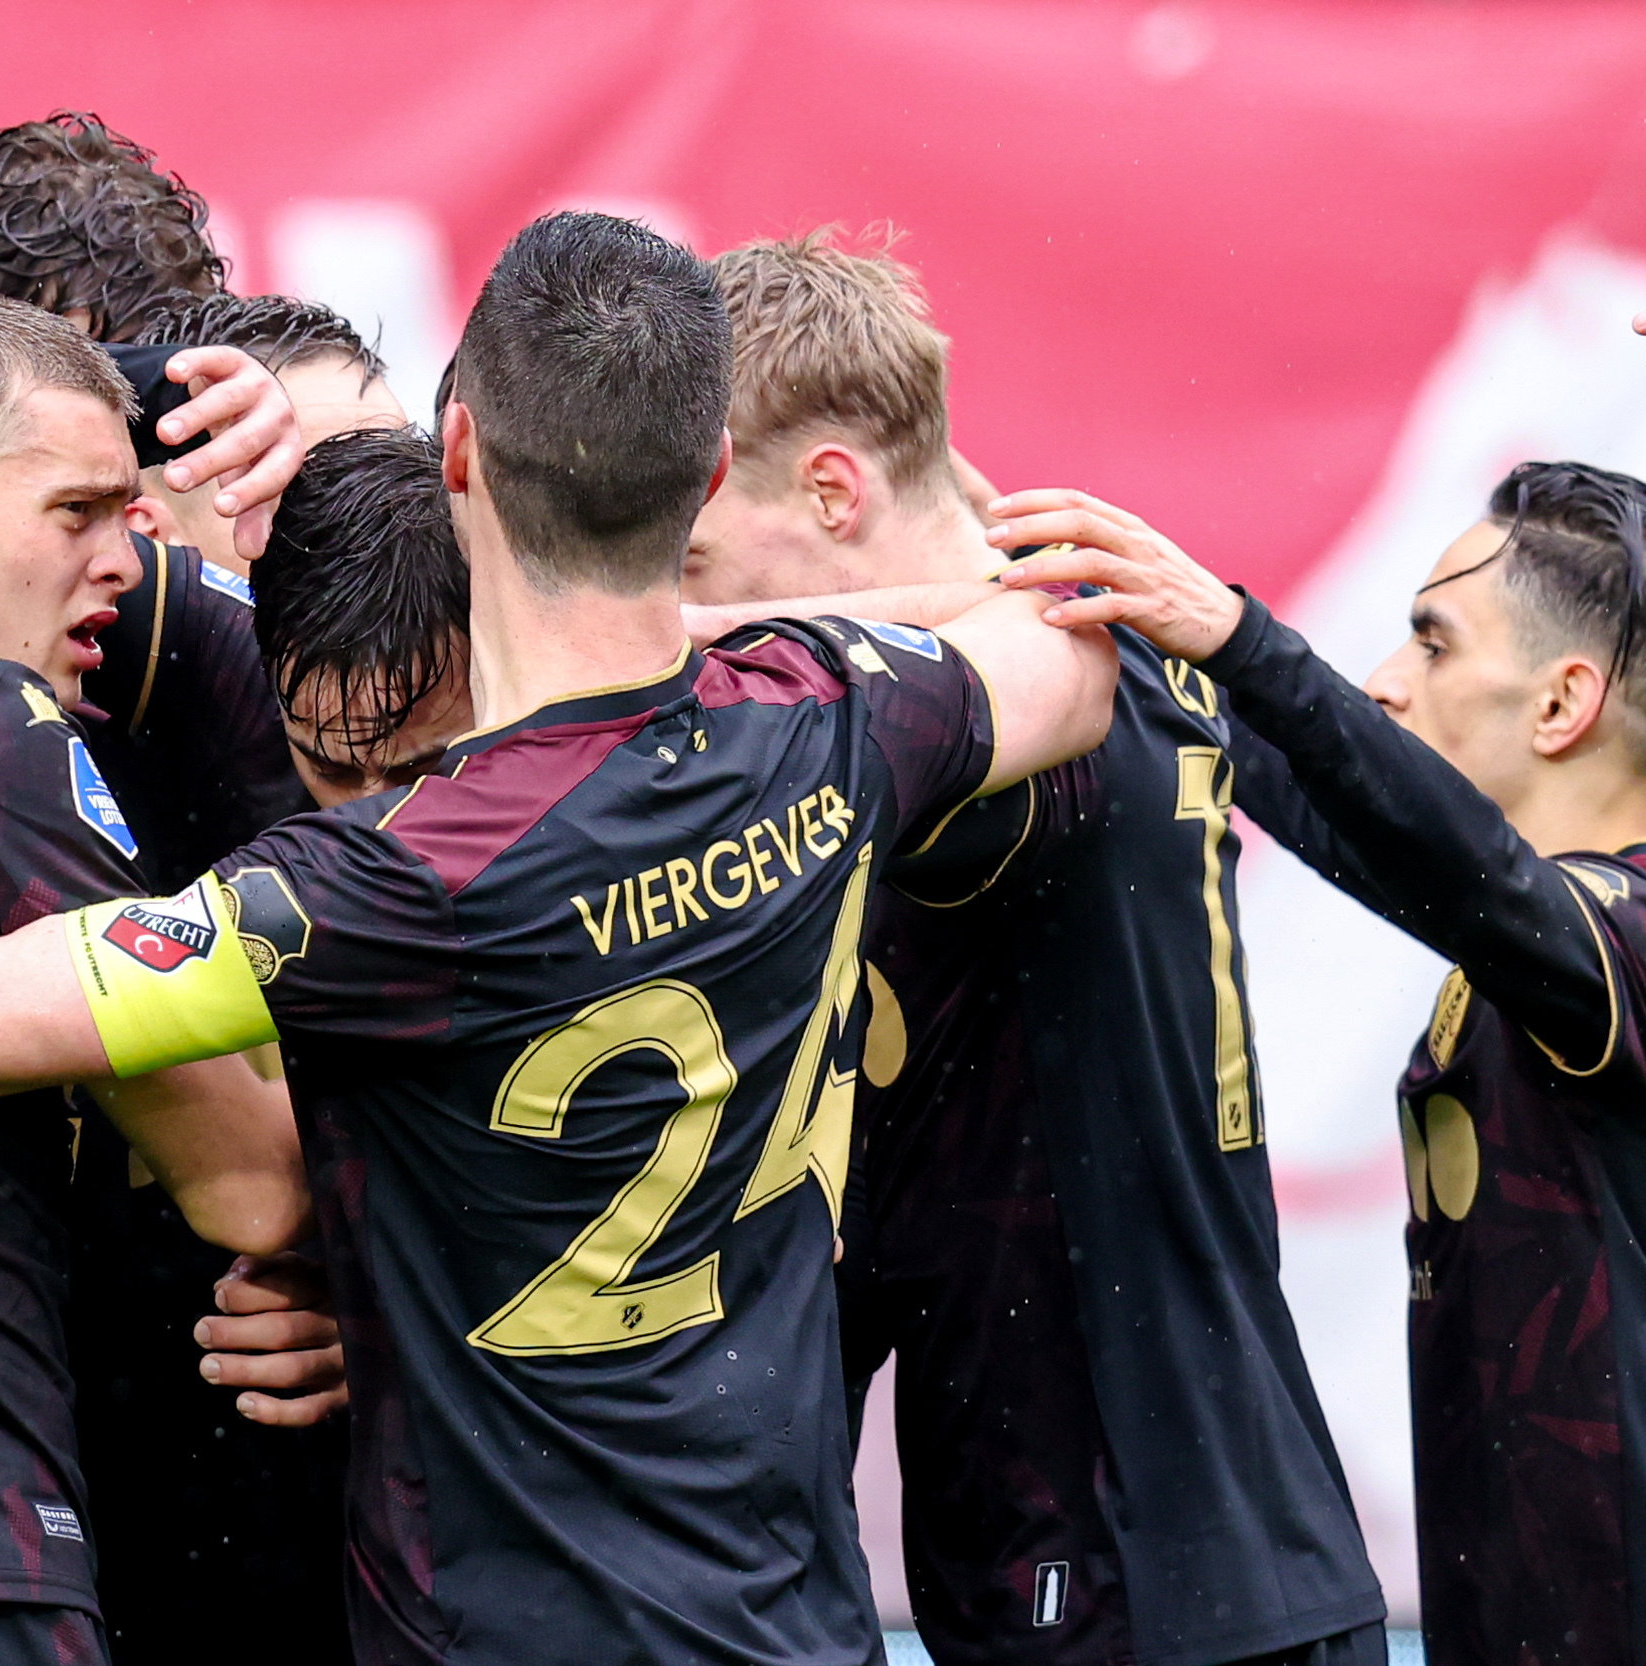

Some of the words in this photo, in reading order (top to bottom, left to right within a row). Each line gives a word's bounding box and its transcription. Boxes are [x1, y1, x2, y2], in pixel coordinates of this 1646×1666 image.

[570, 785, 855, 955] VIERGEVER
[123, 907, 210, 950] UTRECHT
[135, 934, 163, 955] C
[87, 953, 108, 997] UTRECHT
[466, 840, 872, 1357] 24
